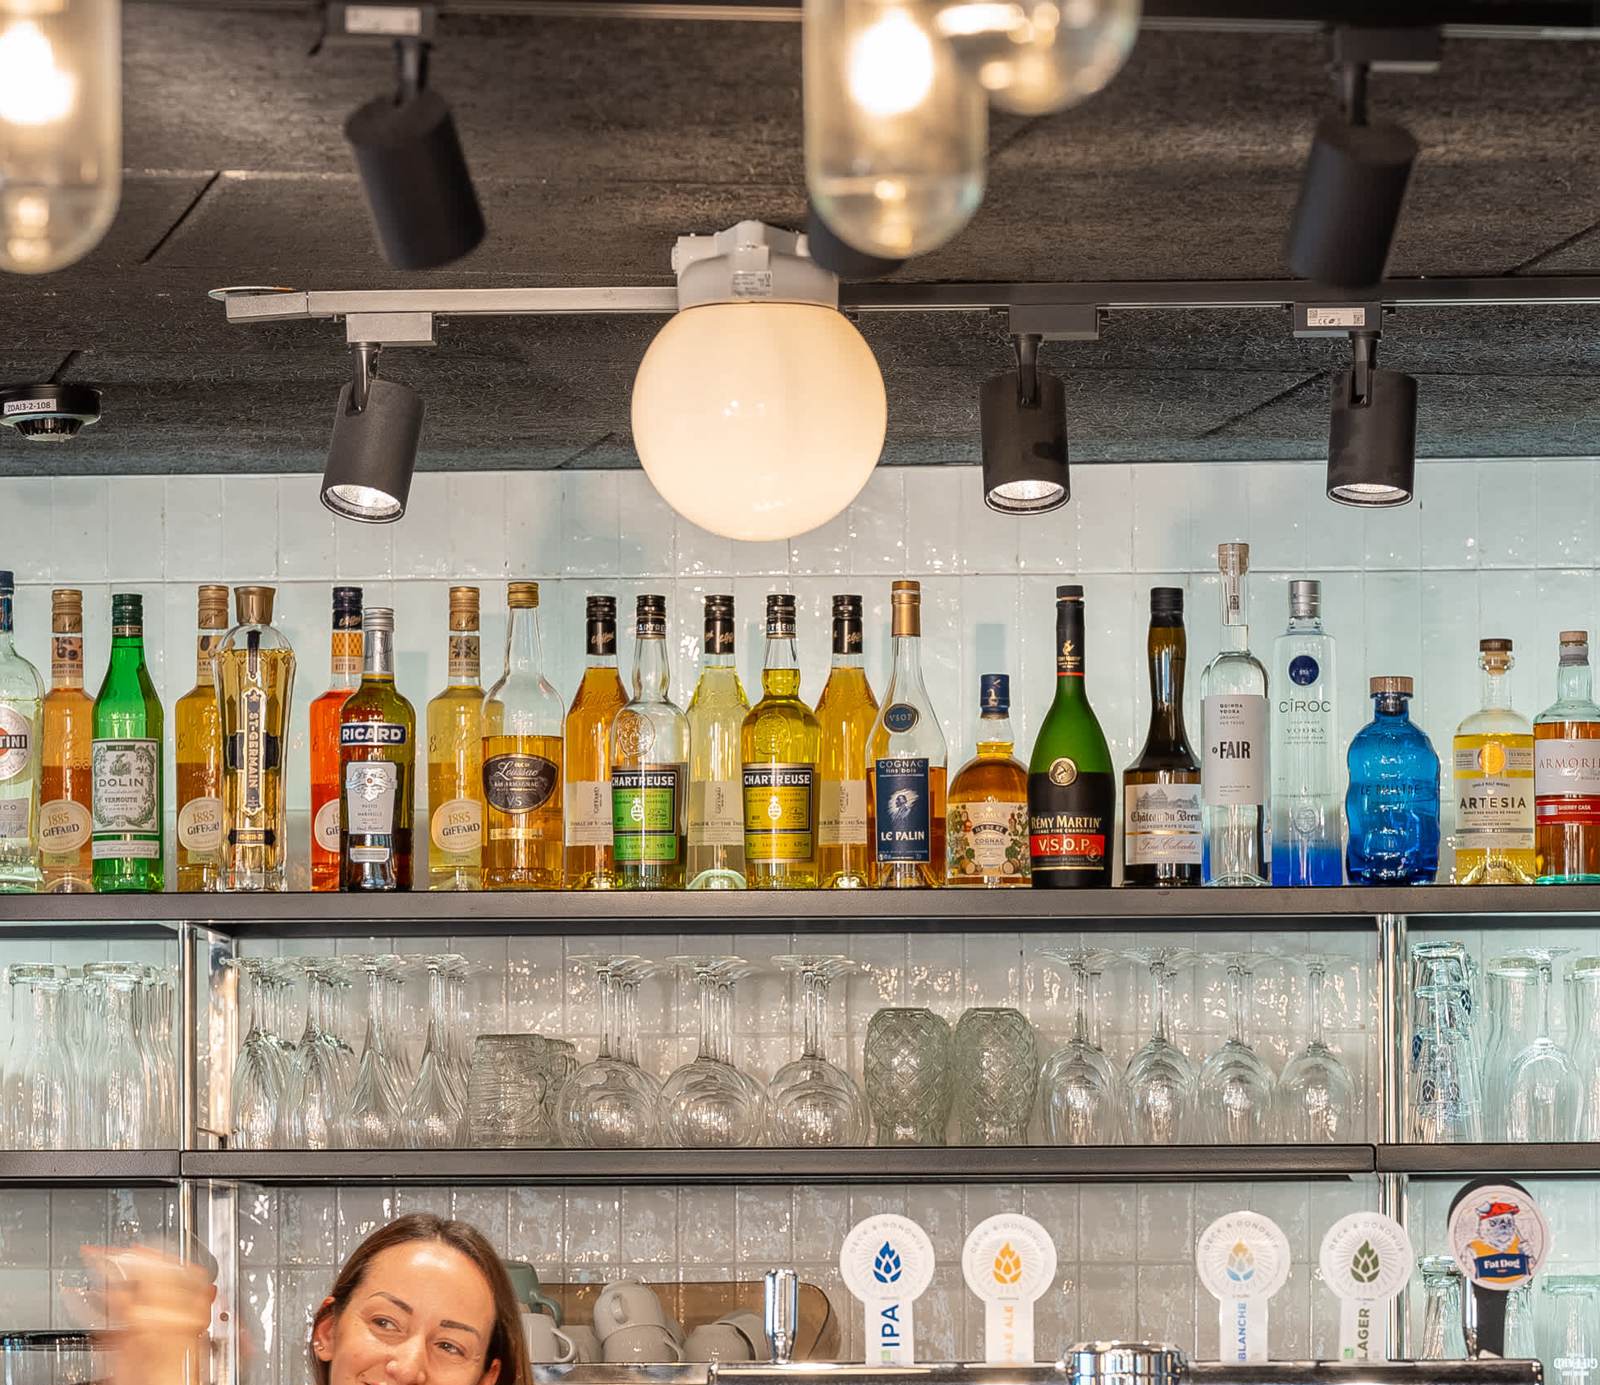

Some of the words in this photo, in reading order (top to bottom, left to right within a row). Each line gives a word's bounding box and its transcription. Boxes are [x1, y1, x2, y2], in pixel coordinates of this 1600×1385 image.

[342, 727, 401, 741] RICARD
[1219, 741, 1251, 759] FAIR
[879, 760, 923, 768] COGNAC
[98, 778, 144, 787] DOLIN
[744, 774, 811, 786] CHARTREUSE
[507, 796, 522, 806] VS
[1460, 797, 1527, 809] ARTESIA
[48, 811, 70, 826] 1885
[447, 810, 471, 825] 1885
[1031, 815, 1055, 829] RÉMY
[1056, 814, 1100, 829] MARTIN
[42, 822, 81, 838] GIFFARD
[442, 822, 481, 837] GIFFARD
[881, 831, 893, 841] LE
[895, 831, 925, 841] PALIN
[1483, 1259, 1500, 1270] Fat
[1500, 1259, 1521, 1269] Dog
[880, 1304, 900, 1347] IPA
[1237, 1302, 1247, 1361] BLANCHE
[1357, 1308, 1370, 1361] LAGER
